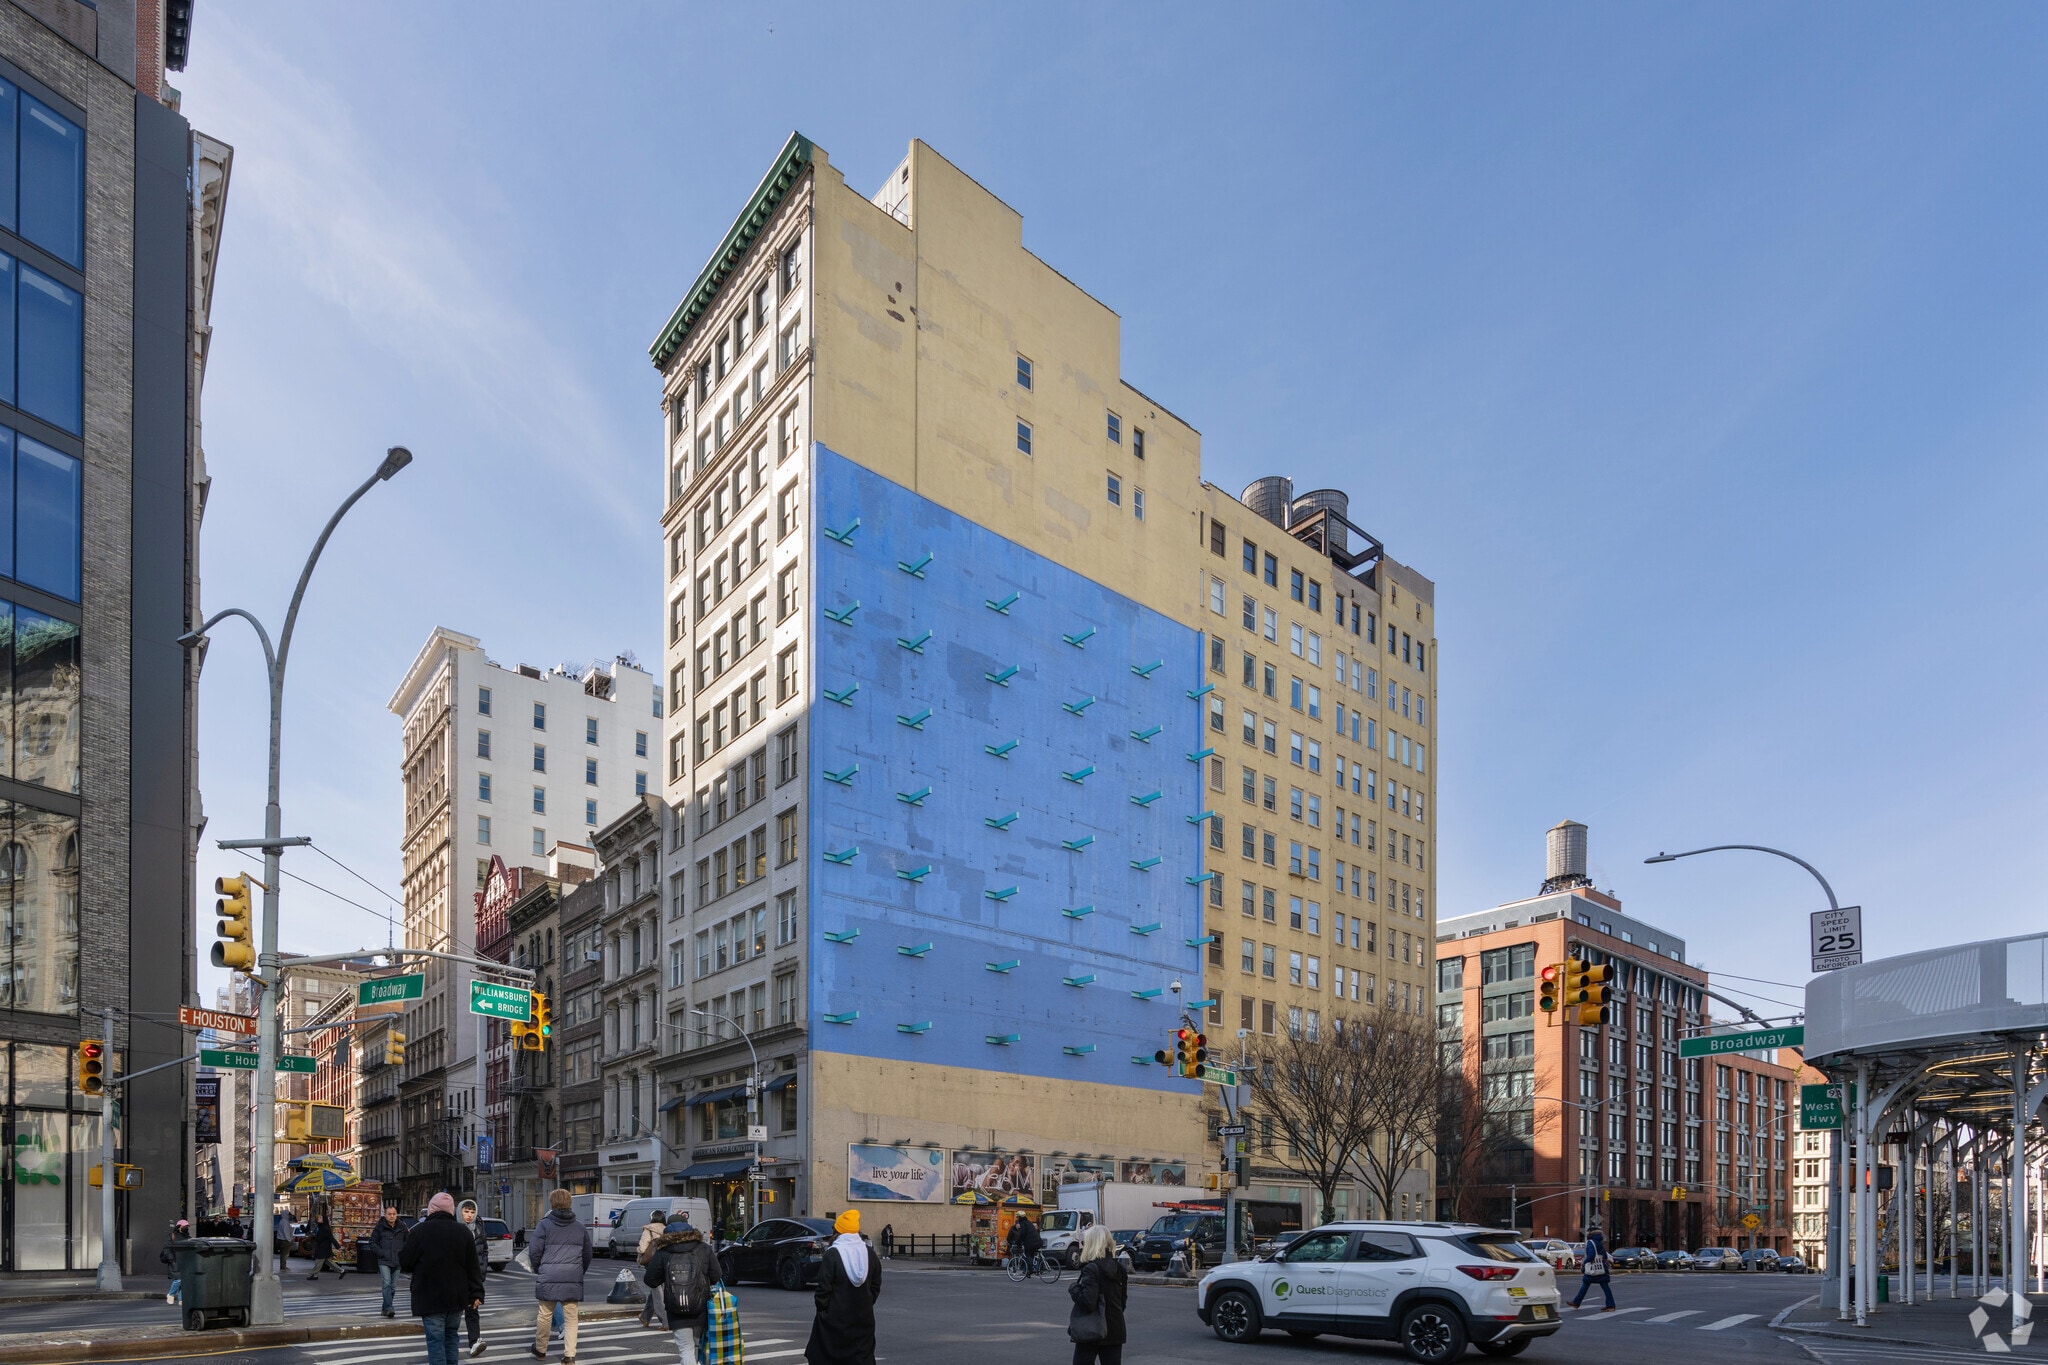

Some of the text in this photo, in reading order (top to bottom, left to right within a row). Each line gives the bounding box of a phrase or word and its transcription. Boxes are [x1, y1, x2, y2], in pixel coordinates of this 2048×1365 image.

[1824, 911, 1845, 919] CITY
[1820, 918, 1850, 927] SPEED
[1823, 925, 1847, 934] LIMIT
[1818, 932, 1856, 953] 25
[1816, 960, 1858, 970] ENFORCED
[371, 982, 407, 999] Broadway
[474, 985, 528, 1003] WILLIAMSBURG
[497, 1003, 524, 1015] BRIDGE
[180, 1008, 257, 1033] E HOUSTON ST
[1710, 1033, 1786, 1051] Broadway
[224, 1054, 230, 1064] E
[284, 1058, 295, 1069] St
[1804, 1102, 1835, 1111] West
[1809, 1115, 1837, 1125] Hwy
[872, 1166, 924, 1182] live your life
[1296, 1284, 1387, 1297] Quest Diagnostics
